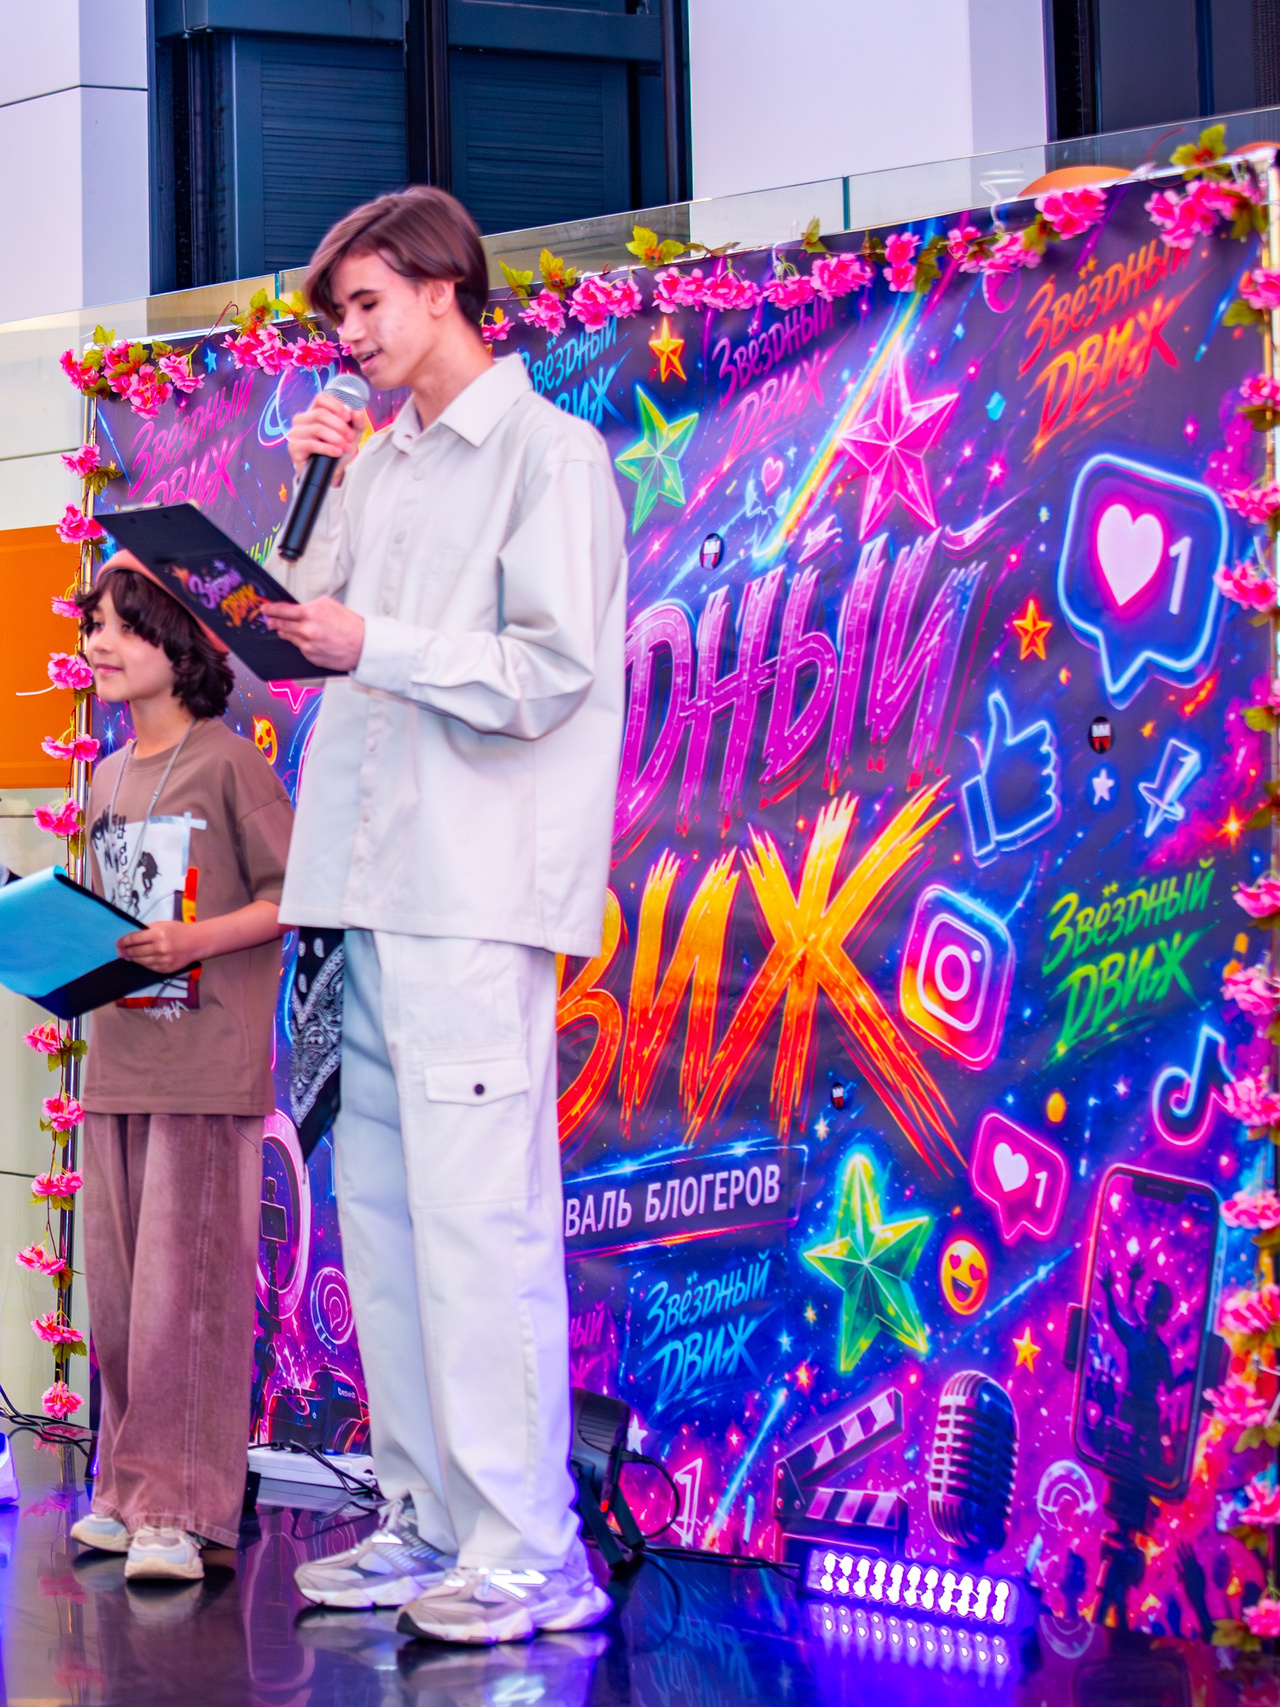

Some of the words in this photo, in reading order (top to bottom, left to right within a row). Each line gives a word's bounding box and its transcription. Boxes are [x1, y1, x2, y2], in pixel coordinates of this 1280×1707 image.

[556, 775, 968, 1180] ВИЖ
[564, 1188, 633, 1238] ВАЛЬ
[644, 1164, 782, 1223] БЛОГЕРОВ
